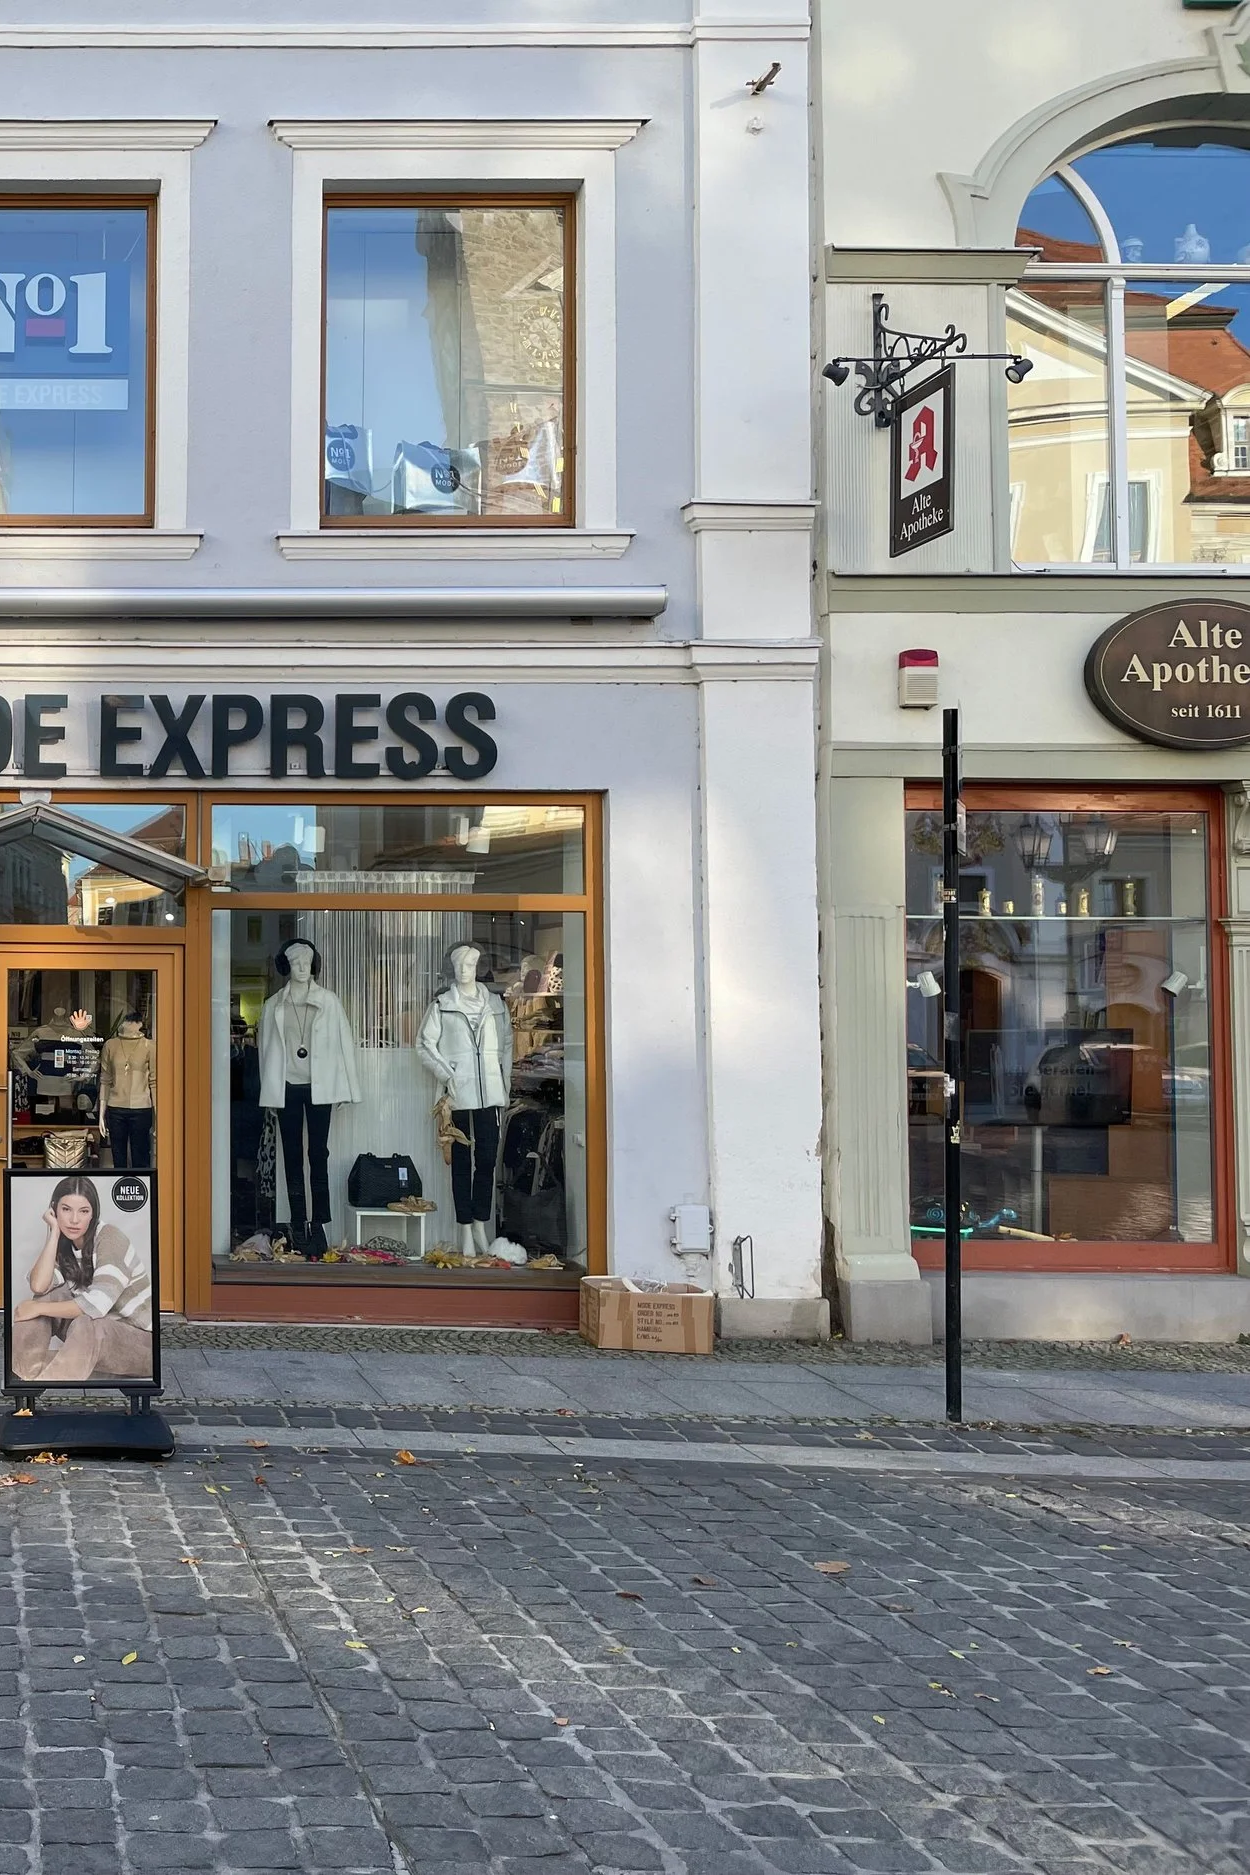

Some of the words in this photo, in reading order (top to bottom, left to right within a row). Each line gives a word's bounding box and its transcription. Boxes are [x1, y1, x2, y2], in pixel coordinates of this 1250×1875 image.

[14, 384, 102, 405] EXPRESS
[911, 492, 932, 515] Alte
[899, 507, 944, 541] Apotheke
[1167, 619, 1243, 649] Alte
[1171, 704, 1200, 718] seit
[1206, 704, 1242, 719] 1611
[100, 691, 499, 781] EXPRESS
[120, 1185, 140, 1195] NEUE
